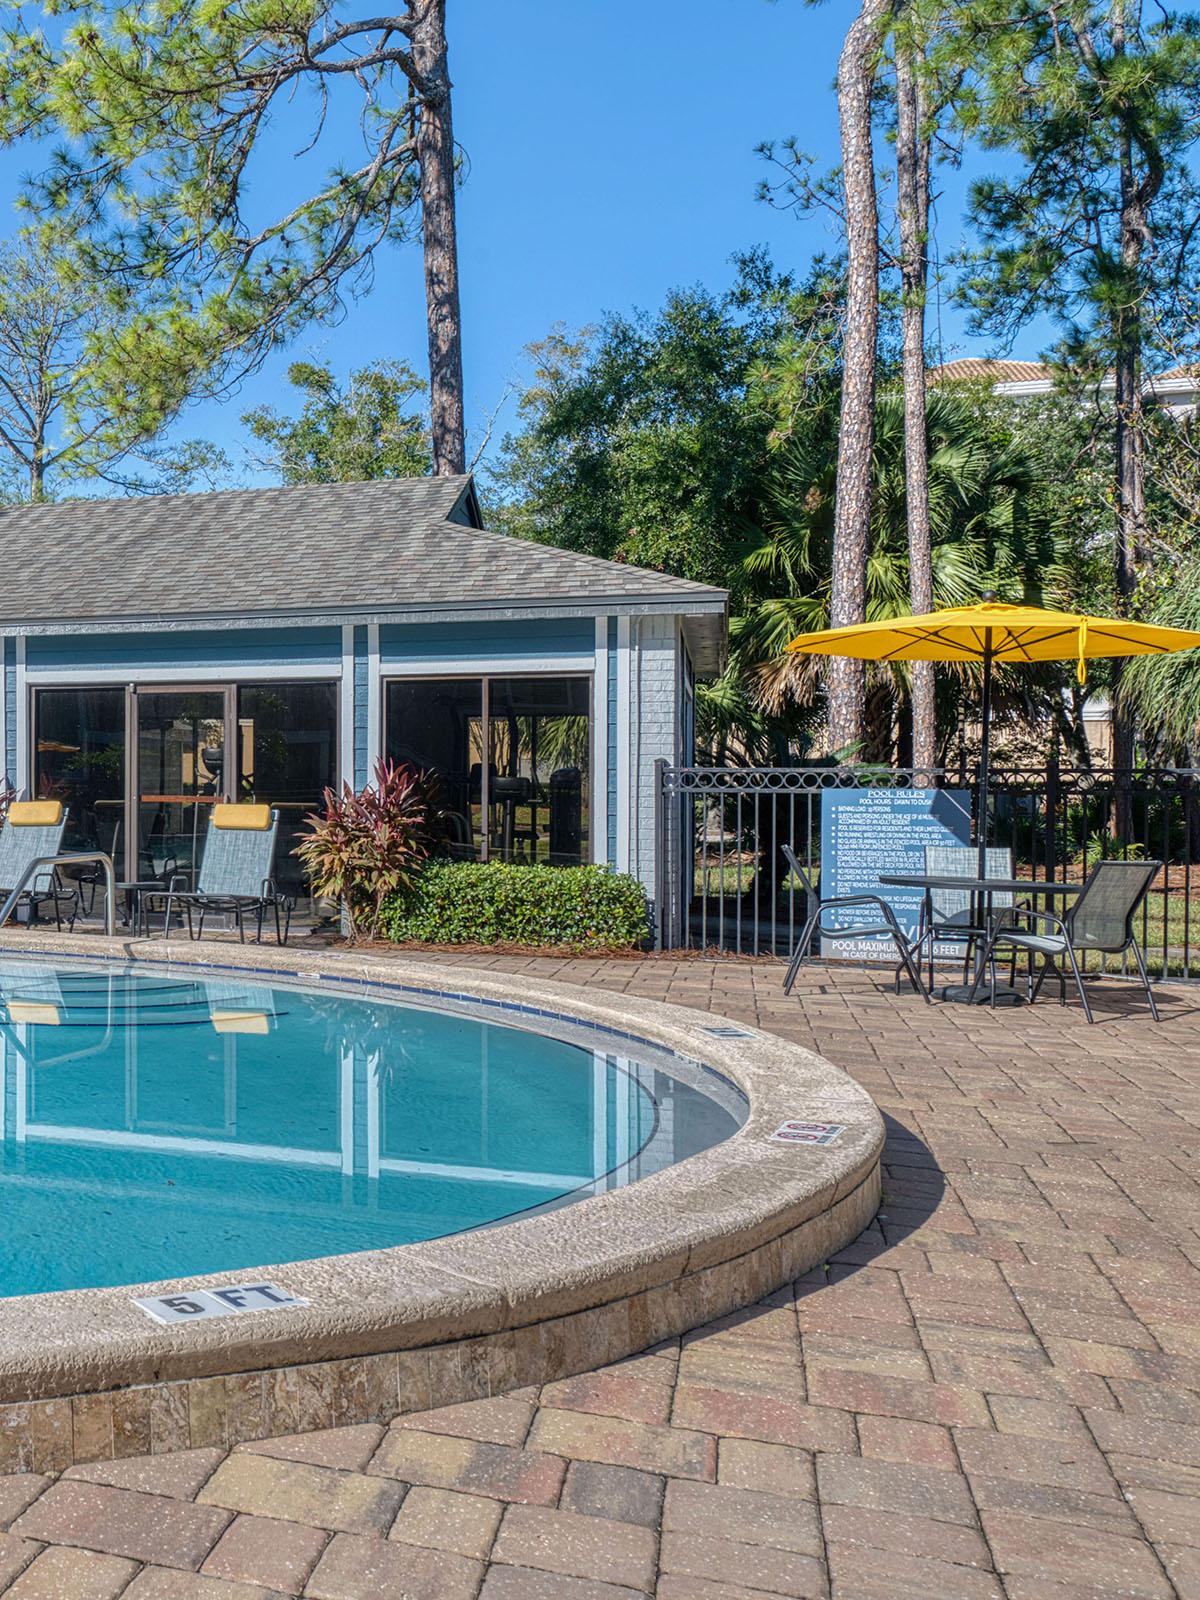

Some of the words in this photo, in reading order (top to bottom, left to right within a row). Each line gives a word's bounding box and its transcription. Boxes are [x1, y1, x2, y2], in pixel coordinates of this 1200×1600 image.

[867, 790, 894, 798] POOL
[896, 790, 926, 798] RULES
[832, 941, 856, 951] POOL
[858, 942, 899, 953] MAXIMUM
[940, 945, 960, 955] FEET
[850, 951, 868, 959] CASE
[158, 1296, 205, 1314] 5
